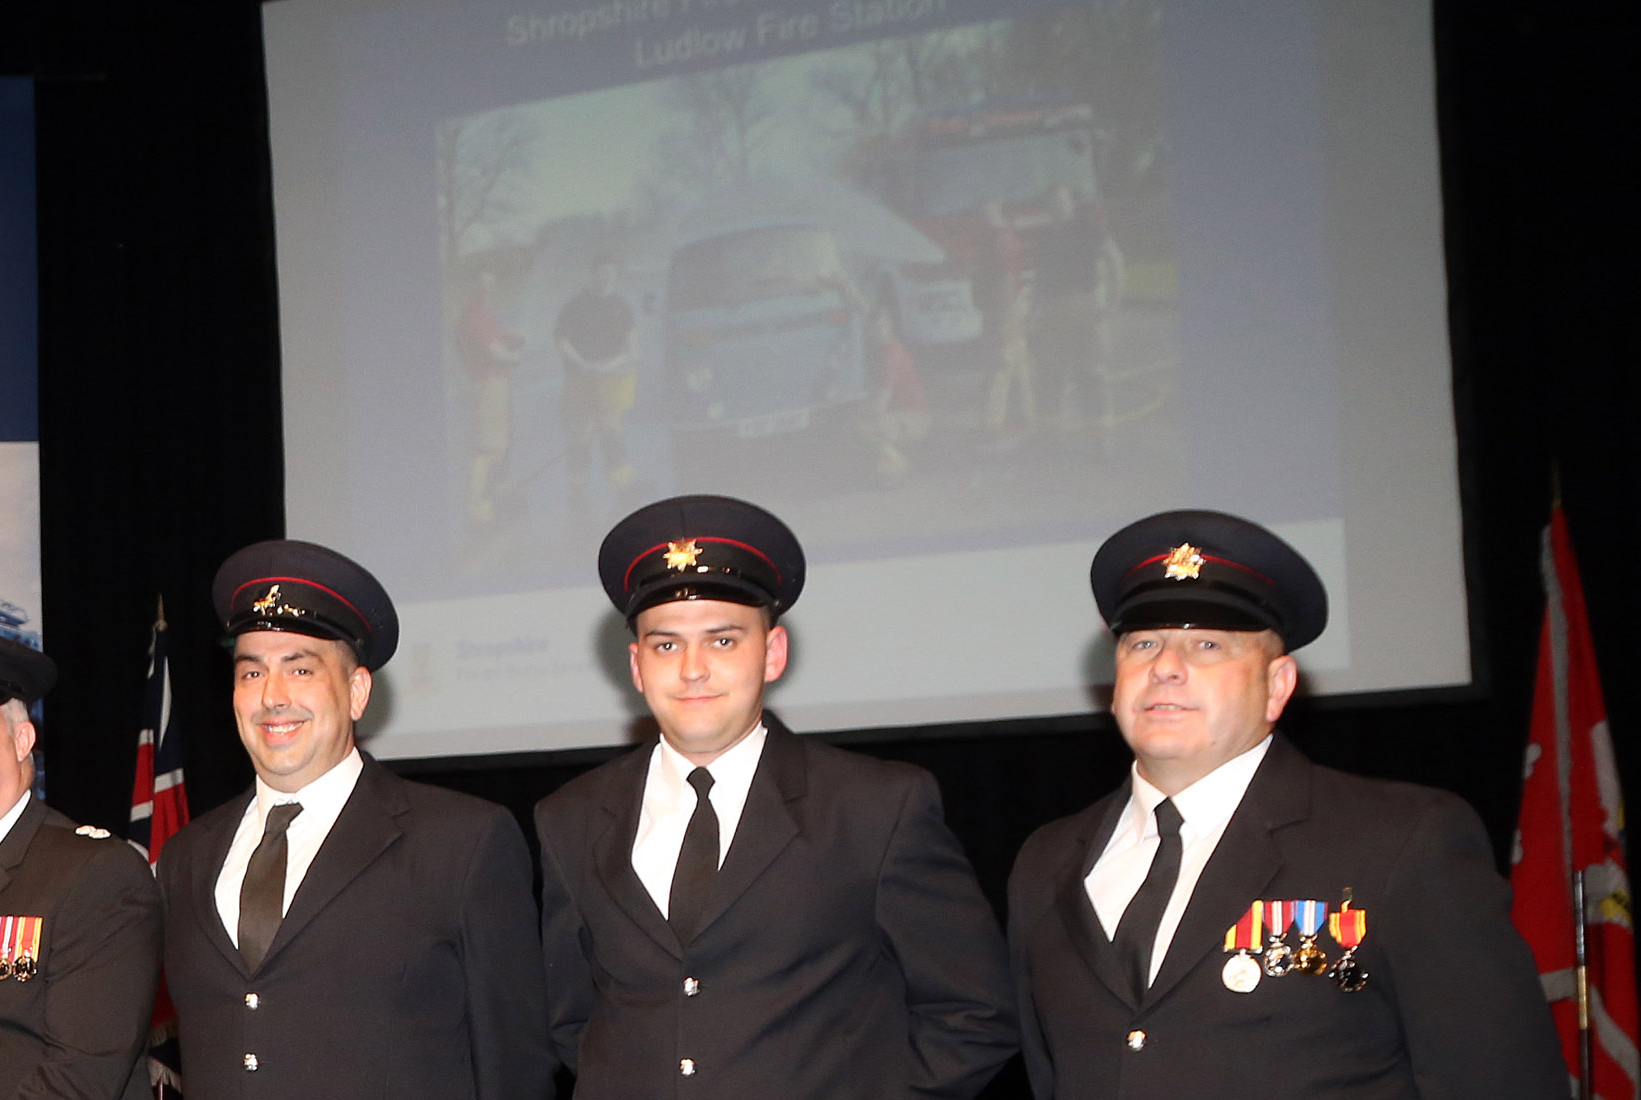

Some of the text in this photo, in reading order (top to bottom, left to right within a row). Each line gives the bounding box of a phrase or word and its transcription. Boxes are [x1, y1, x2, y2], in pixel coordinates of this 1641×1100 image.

[507, 0, 671, 48] Shropshire
[635, 0, 947, 70] Ludlow Fire Station
